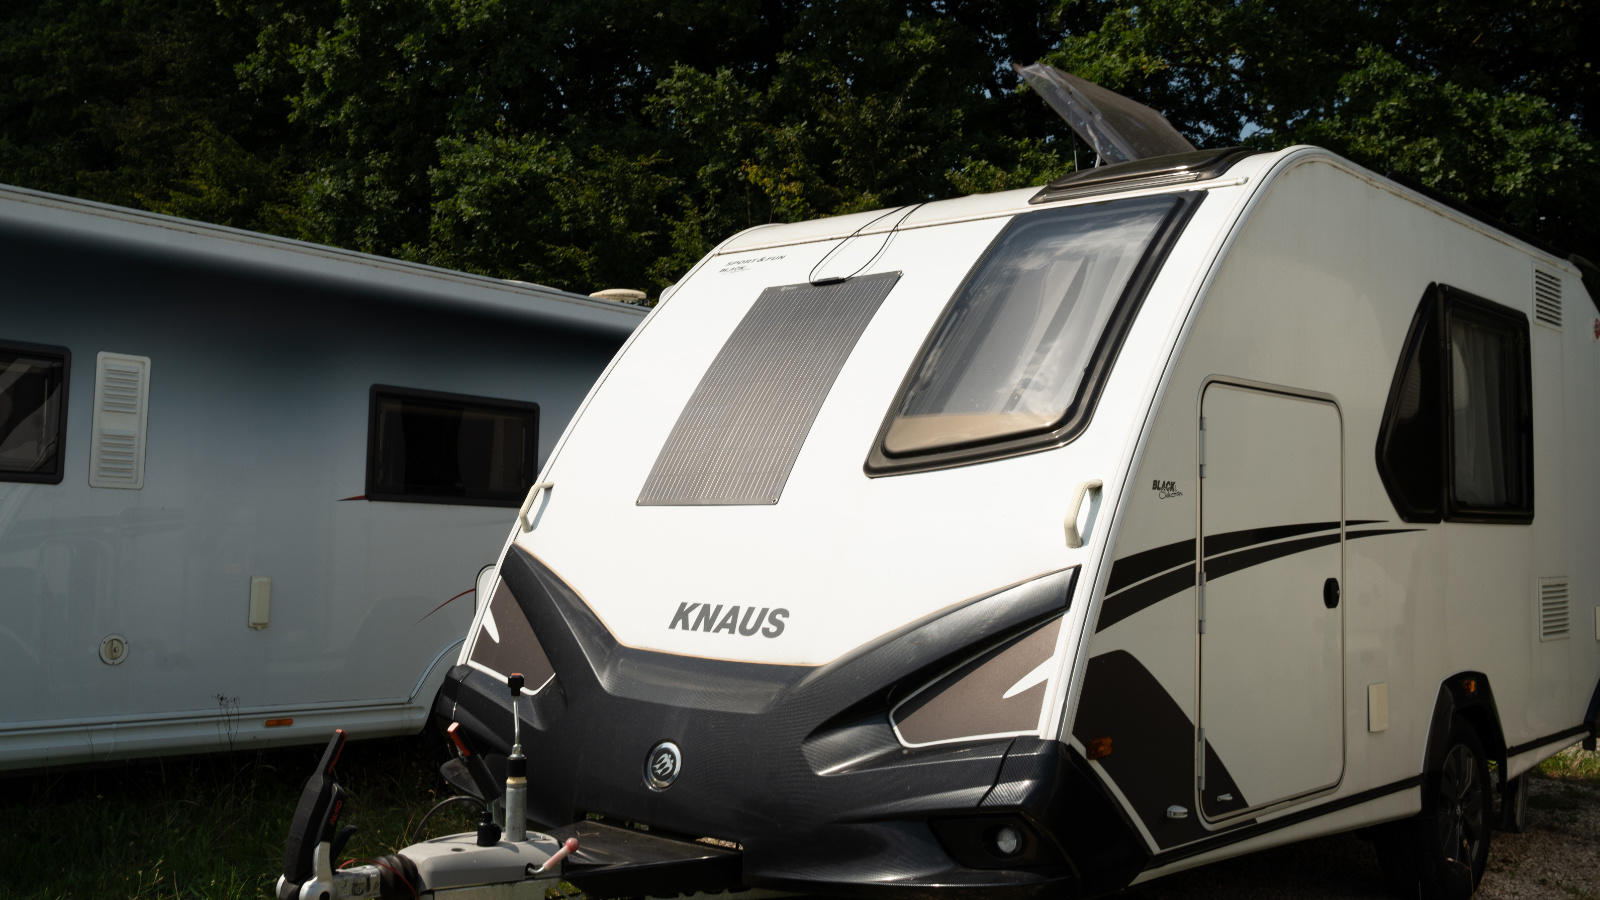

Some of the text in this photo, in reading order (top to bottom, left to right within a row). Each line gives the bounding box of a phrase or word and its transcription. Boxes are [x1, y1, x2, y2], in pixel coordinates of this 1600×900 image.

[726, 257, 757, 266] SPORT
[765, 254, 787, 262] FUN
[1152, 479, 1176, 492] BLACK
[668, 601, 790, 639] KNAUS
